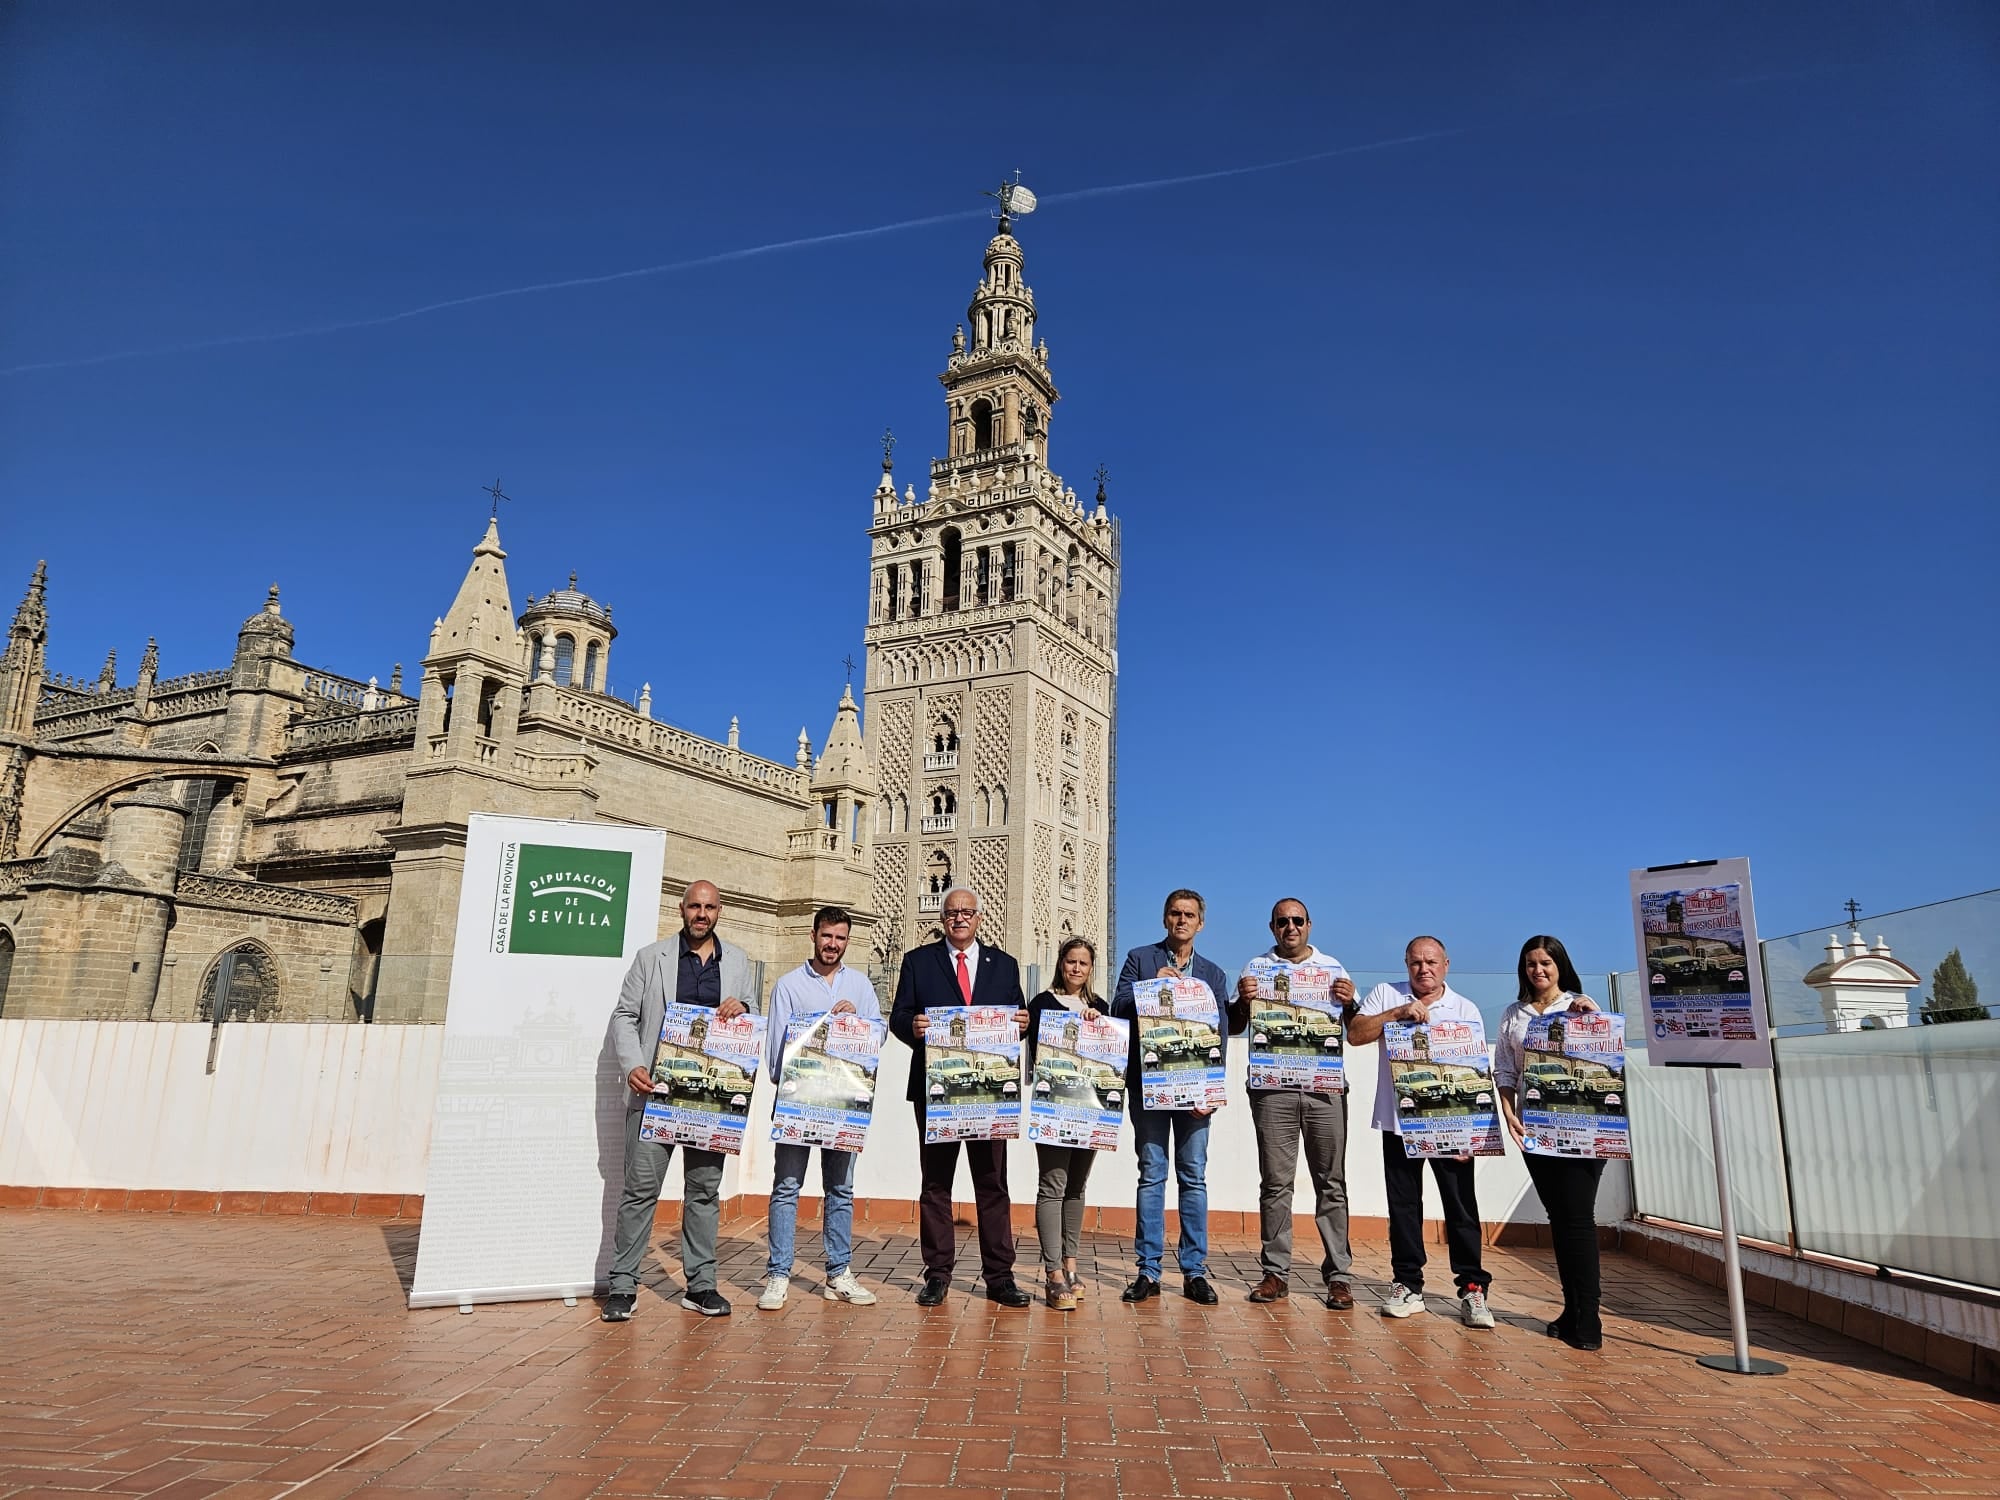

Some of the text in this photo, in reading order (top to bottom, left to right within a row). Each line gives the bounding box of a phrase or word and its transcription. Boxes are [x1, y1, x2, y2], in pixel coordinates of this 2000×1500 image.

[529, 872, 617, 894] DIPUTACION
[496, 842, 517, 953] CASA DE LA PROVINCIA
[565, 897, 579, 906] DE
[528, 909, 611, 927] SEVILLA
[1707, 910, 1740, 929] SEVILLA
[666, 1018, 691, 1026] SEVILLA
[1454, 1039, 1487, 1057] SEVILLA
[1589, 1037, 1623, 1053] SEVILLA
